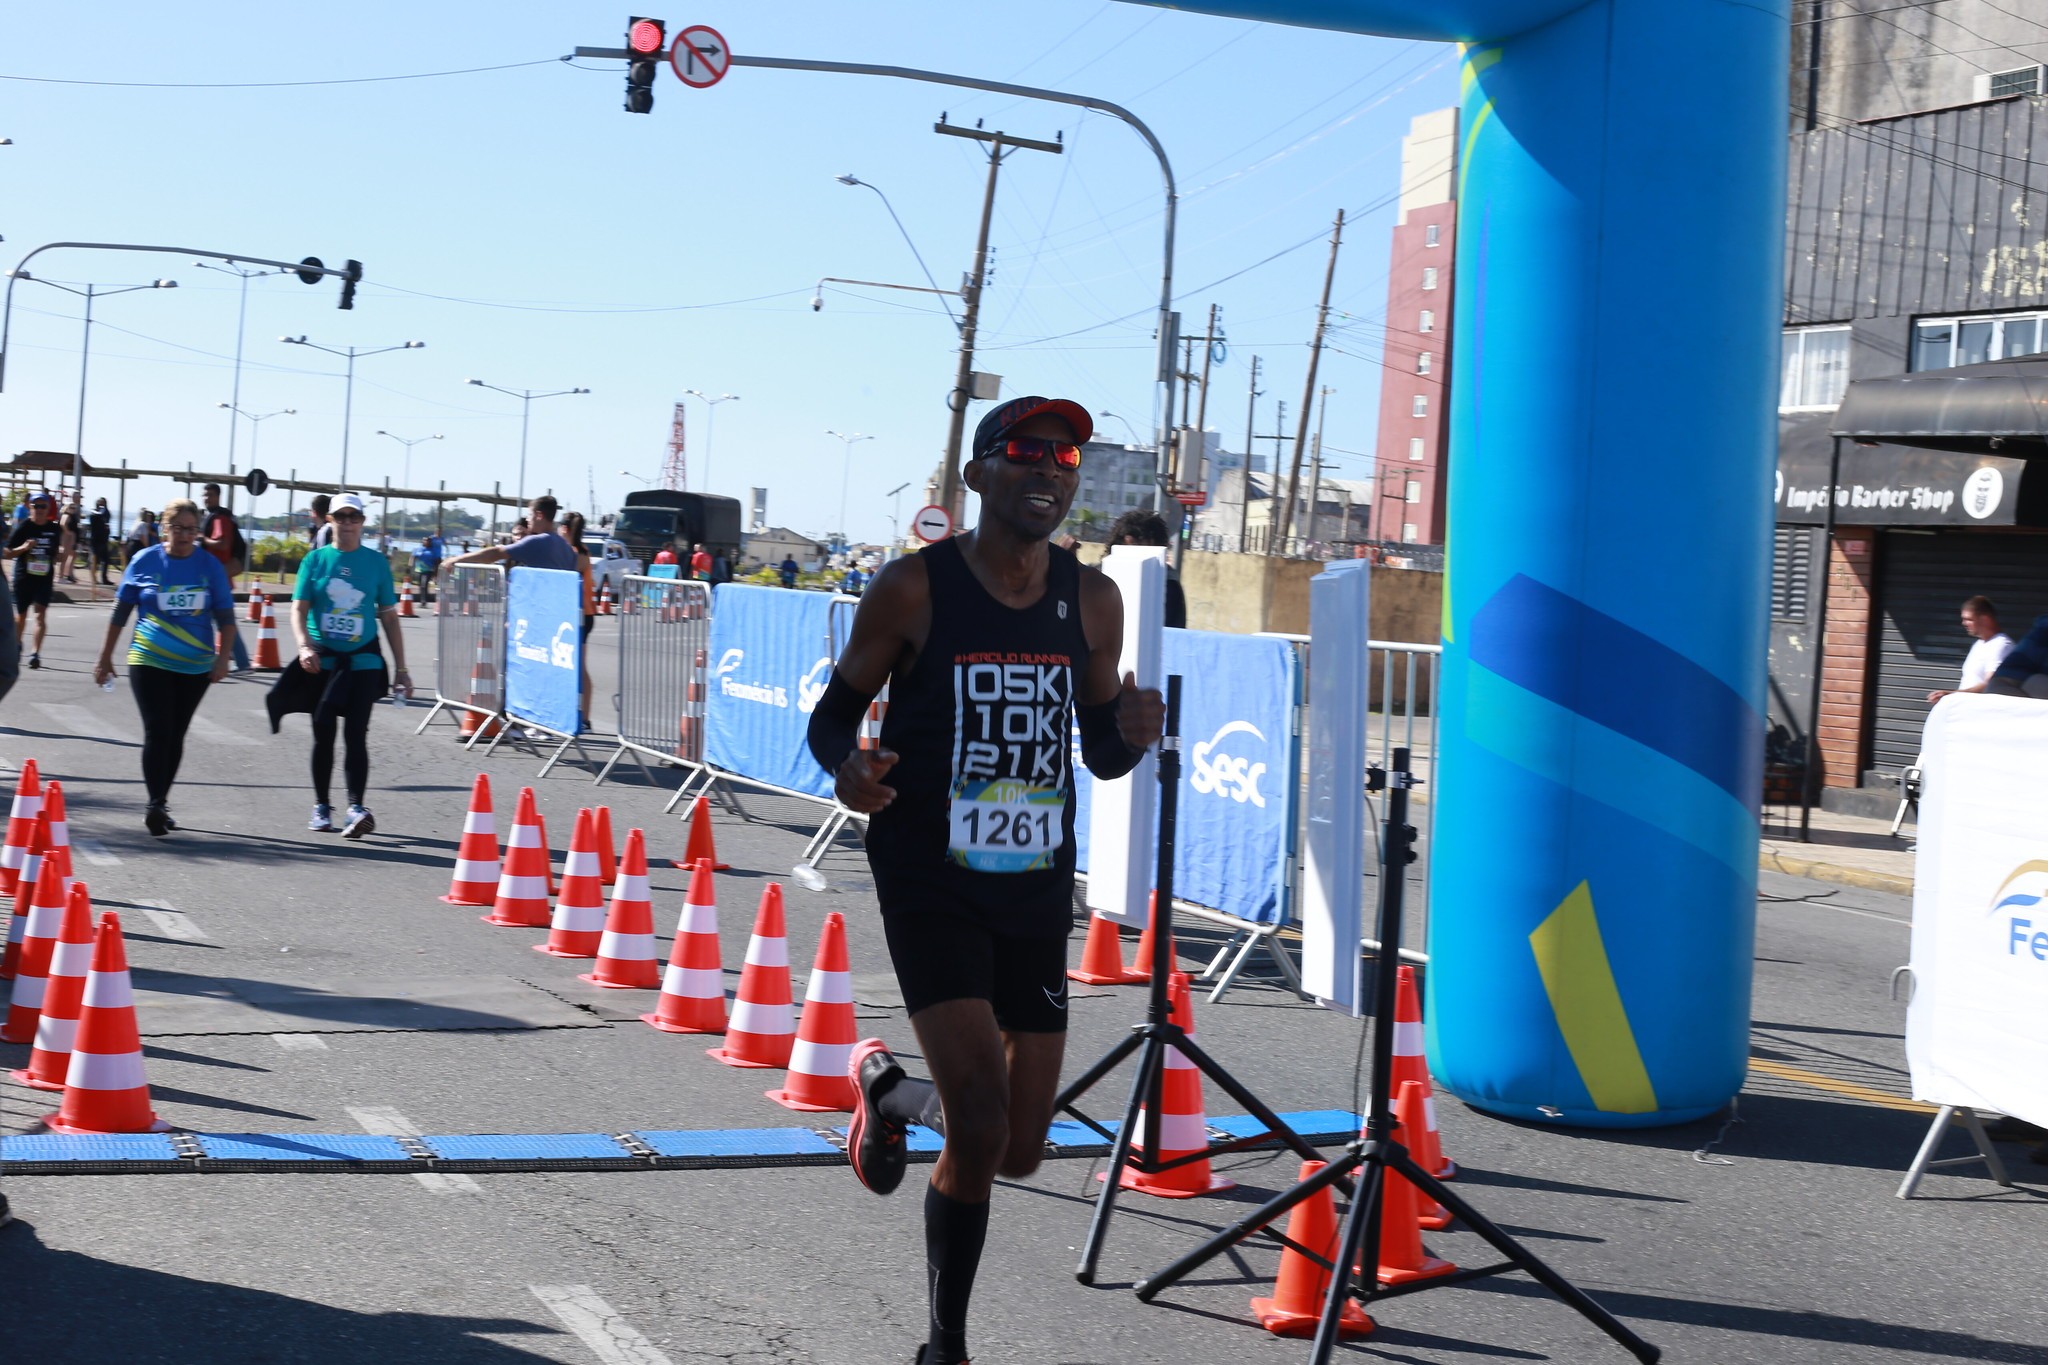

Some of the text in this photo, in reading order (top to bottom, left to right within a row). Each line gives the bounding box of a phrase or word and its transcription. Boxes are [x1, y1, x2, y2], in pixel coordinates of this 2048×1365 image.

[1851, 485, 1909, 509] Barber
[1910, 486, 1954, 514] Shop
[167, 594, 196, 607] 487
[327, 616, 355, 632] 359
[1021, 653, 1071, 666] RUNNERS
[968, 664, 1062, 702] 05K
[976, 705, 1060, 743] 10K
[963, 741, 1058, 778] 21K
[1190, 733, 1266, 808] Sesc
[994, 786, 1029, 805] 10K
[963, 807, 1050, 848] 1261
